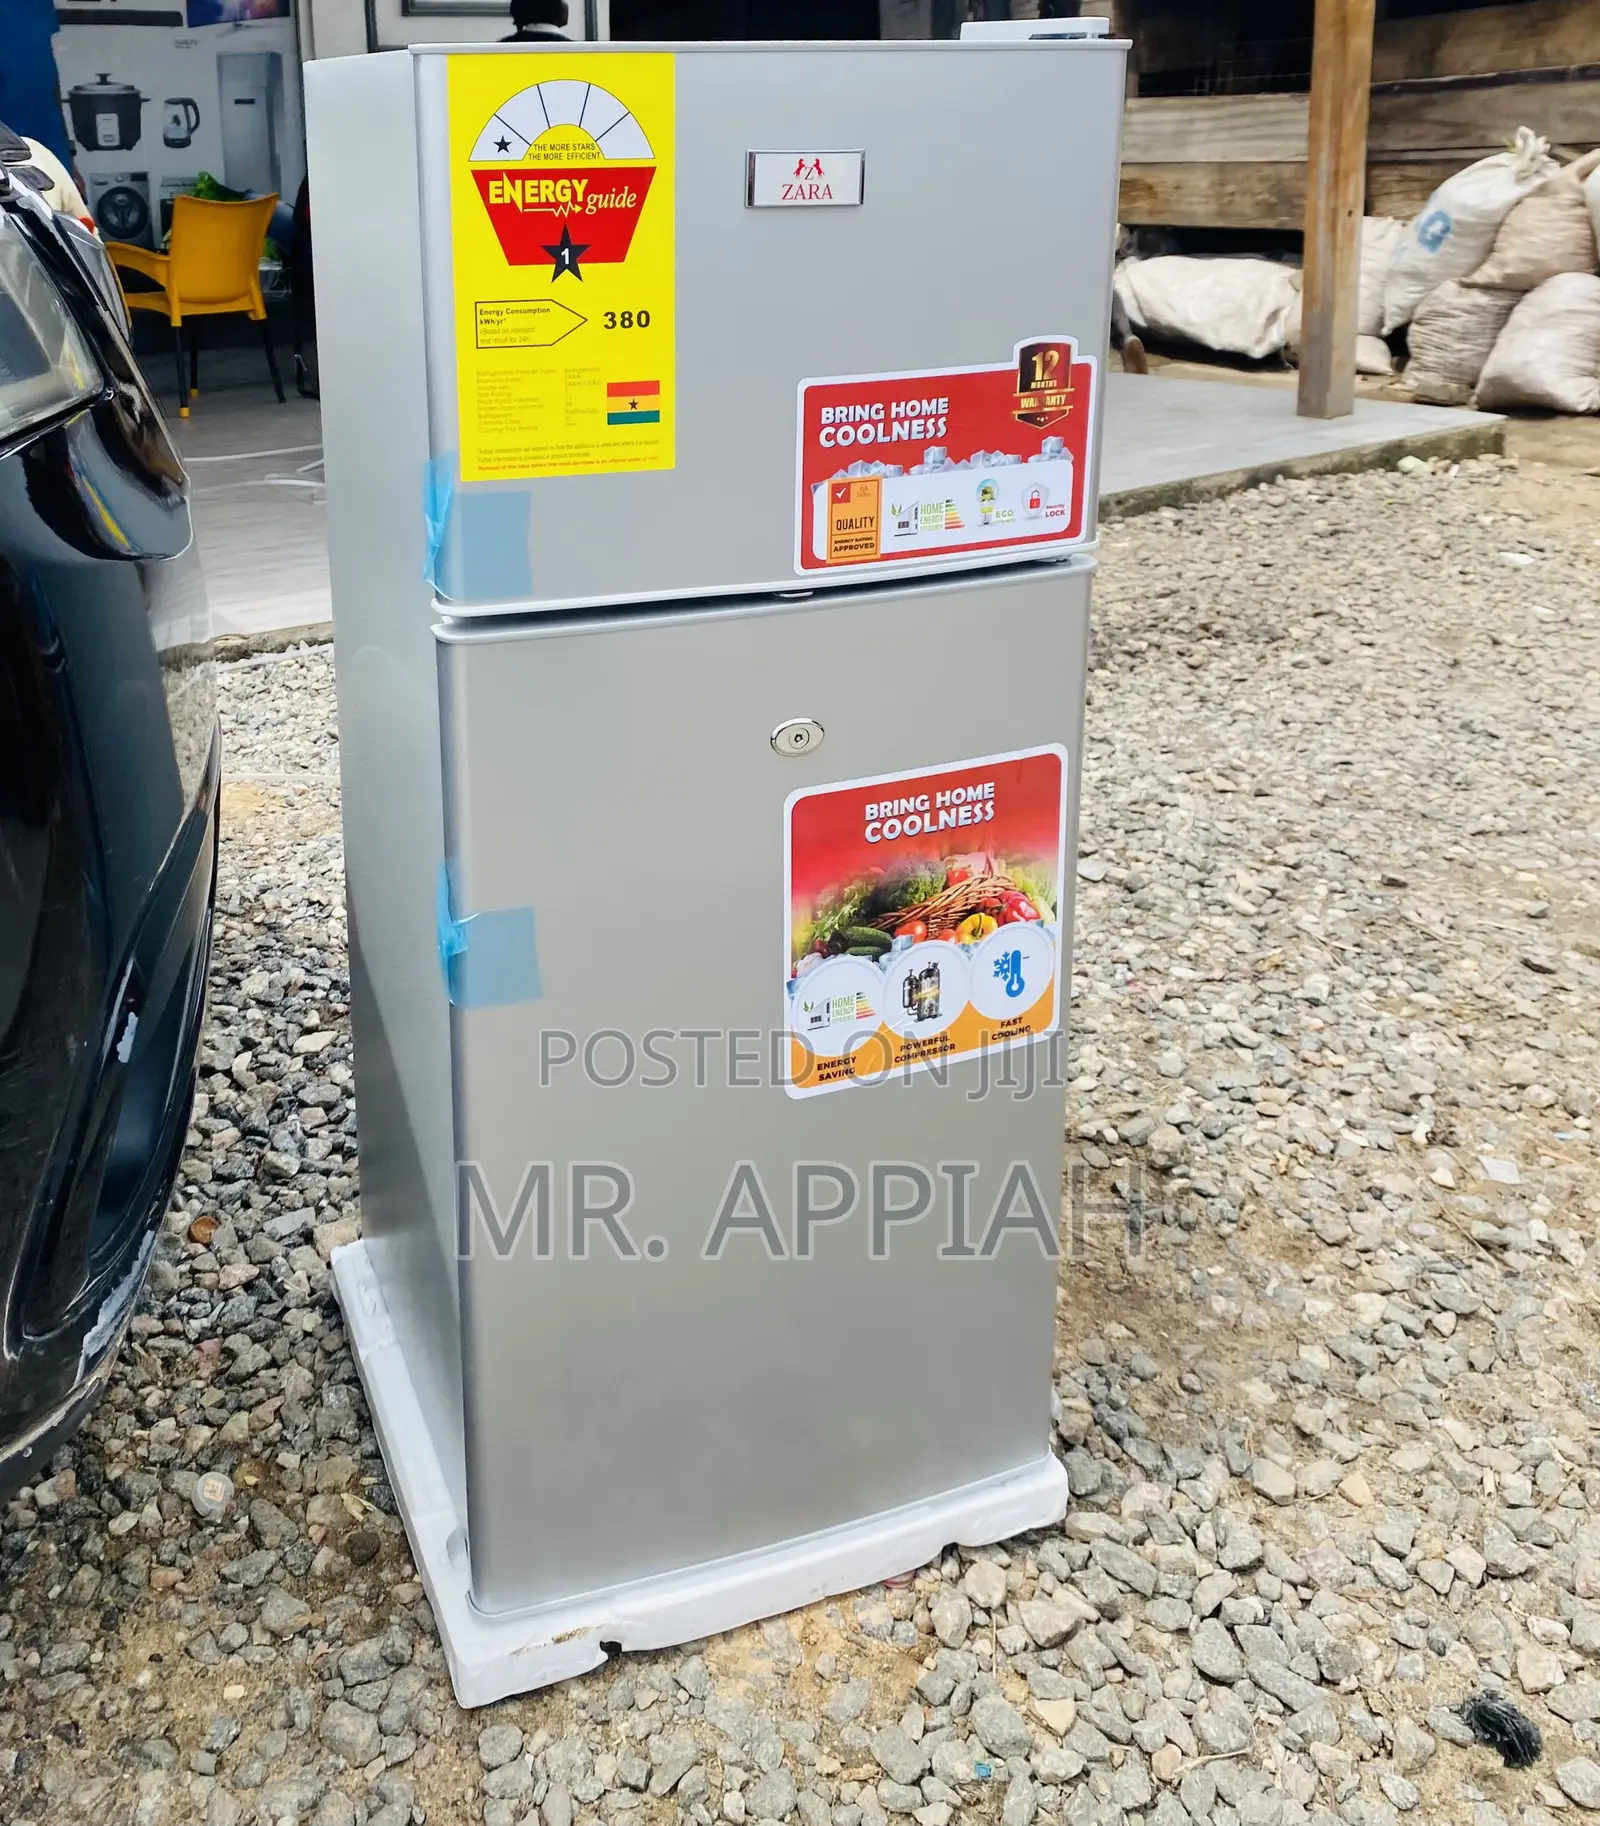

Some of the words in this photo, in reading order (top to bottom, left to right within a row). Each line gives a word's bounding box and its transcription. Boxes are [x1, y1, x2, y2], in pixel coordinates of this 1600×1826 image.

[572, 143, 595, 151] STARS
[566, 152, 601, 160] EFFICIENT
[488, 172, 589, 213] ENERGY
[782, 183, 833, 200] ZARA
[585, 186, 637, 215] guide
[561, 248, 570, 265] 1
[479, 308, 504, 316] Energy
[505, 306, 551, 315] Consumption
[603, 310, 651, 330] 380
[1032, 350, 1059, 381] 12
[1030, 380, 1058, 389] MONTHS
[821, 403, 885, 425] BRING
[890, 397, 949, 419] HOME
[819, 416, 948, 448] COOLNESS
[920, 501, 945, 515] HOME
[995, 510, 1014, 519] ECO
[1045, 509, 1066, 518] LOCK
[836, 516, 875, 531] QUALITY
[833, 542, 875, 553] APPROVED
[865, 794, 930, 821] BRING
[935, 782, 995, 809] HOME
[865, 800, 995, 843] COOLNESS
[832, 995, 855, 1009] HOME
[1000, 1016, 1024, 1029] FAST
[991, 1025, 1031, 1041] COOLING
[900, 1035, 951, 1052] POWERFUL
[894, 1043, 956, 1064] COMPRESSOR
[817, 1055, 857, 1071] ENERGY
[818, 1067, 856, 1082] SAVING
